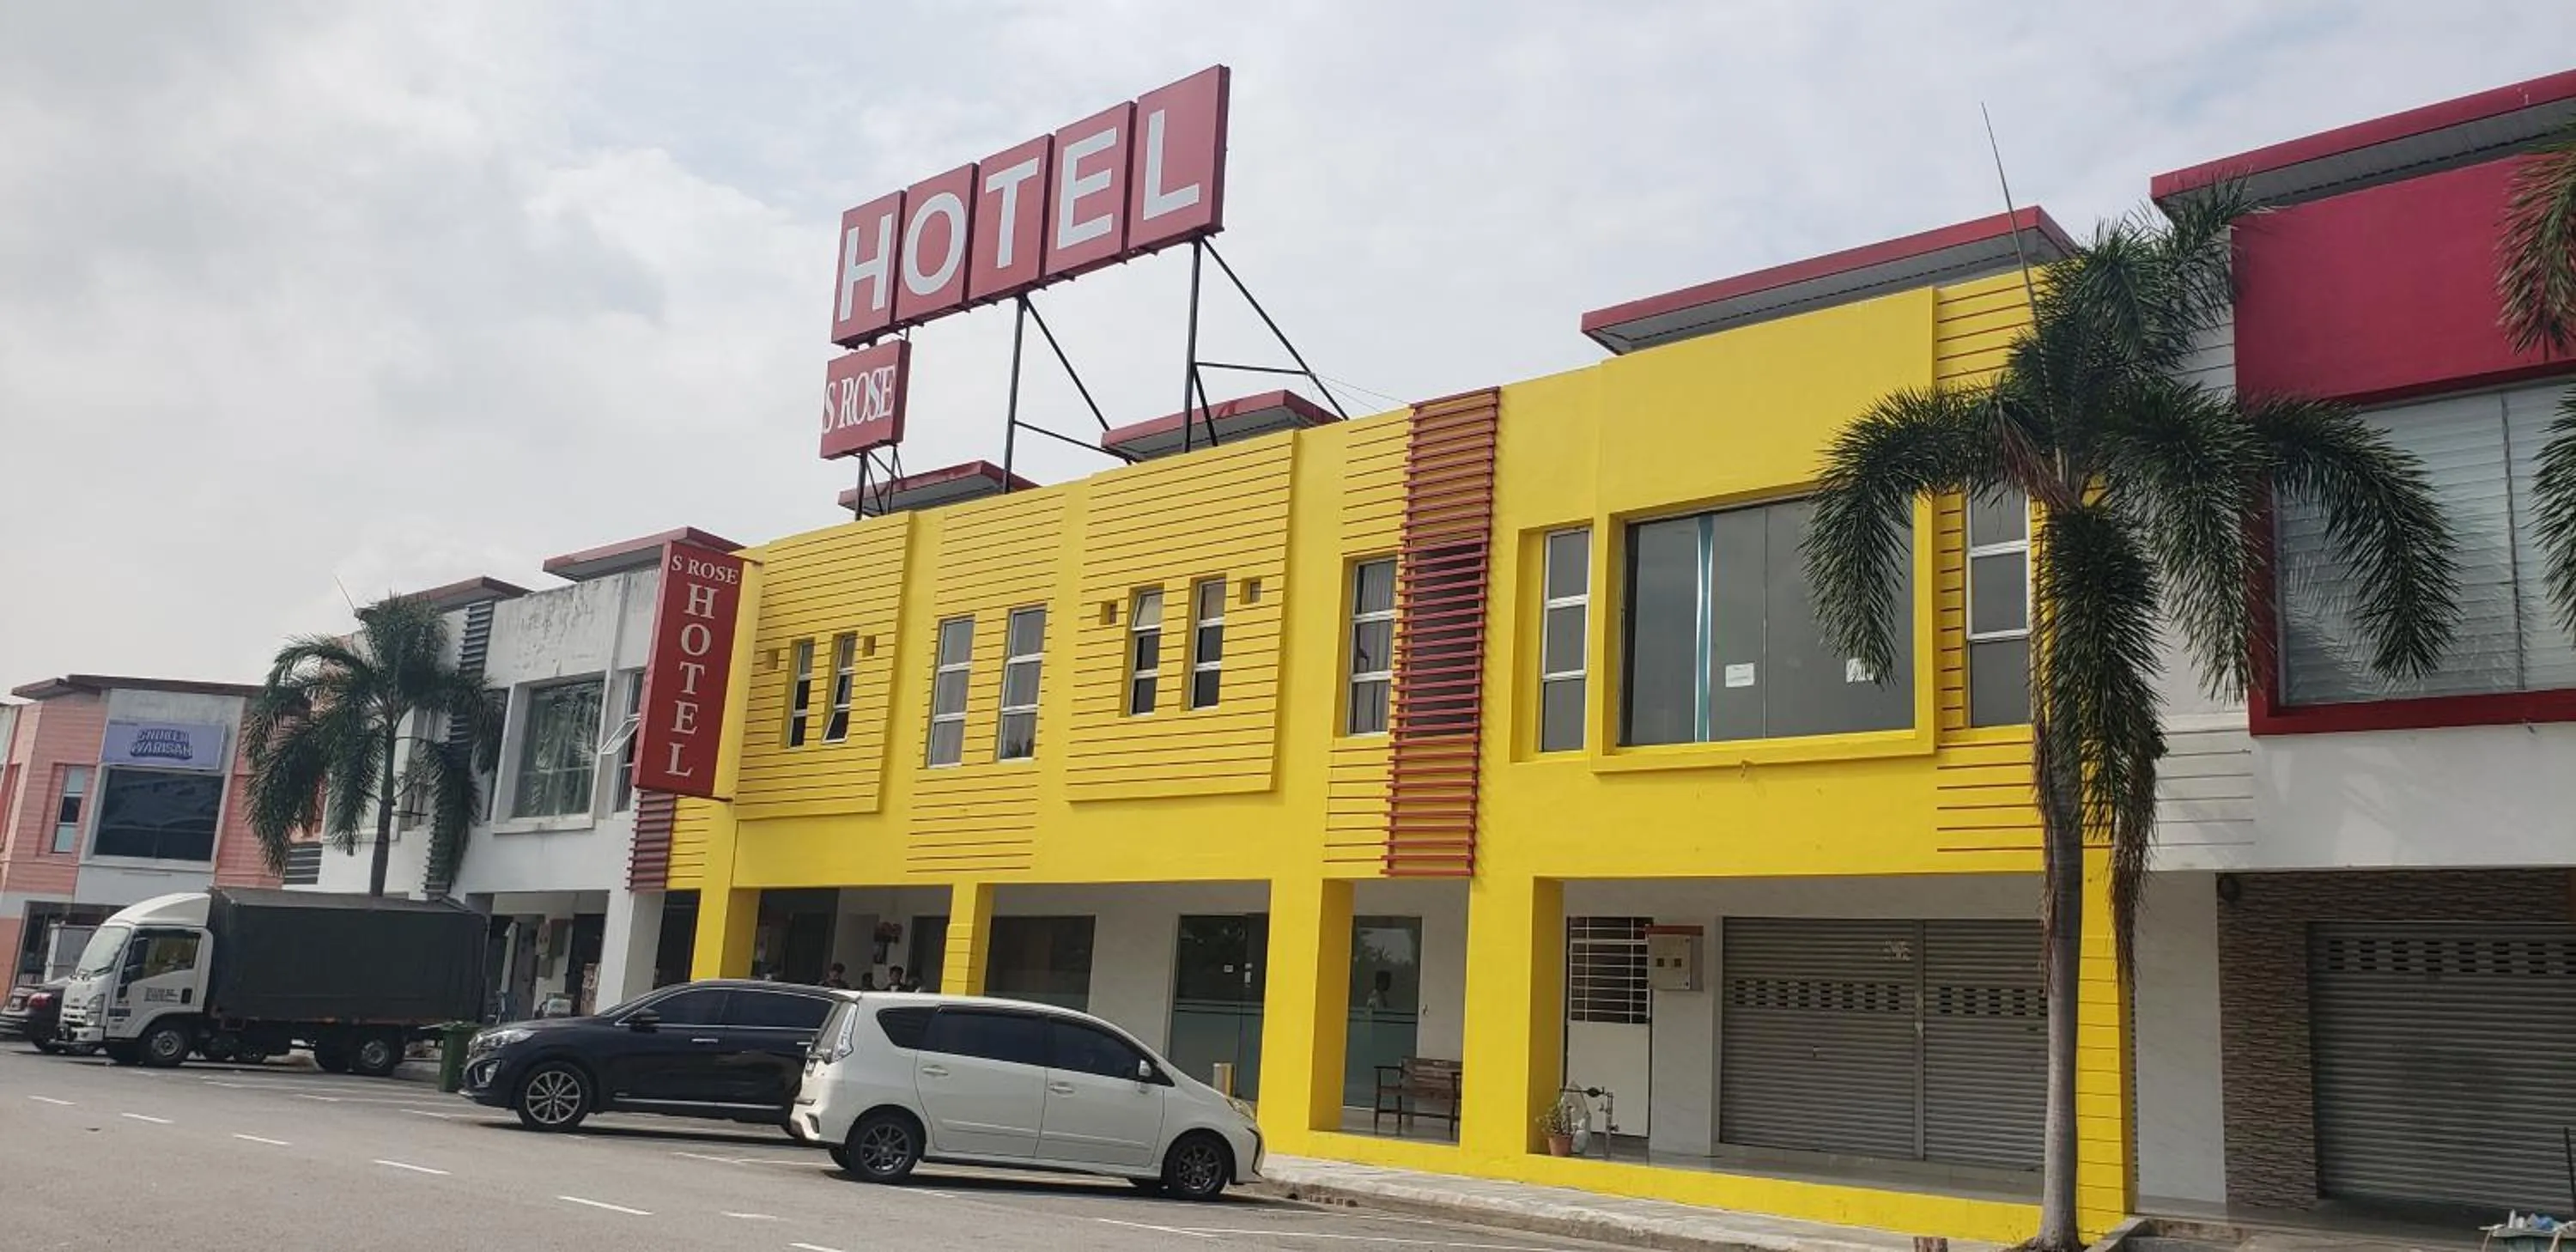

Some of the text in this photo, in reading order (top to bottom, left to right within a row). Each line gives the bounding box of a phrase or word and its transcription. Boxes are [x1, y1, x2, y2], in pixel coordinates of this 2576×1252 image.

[840, 110, 1200, 321] HOTEL
[823, 364, 896, 434] S ROSE
[671, 554, 738, 585] S ROSE
[666, 583, 719, 777] HOTEL
